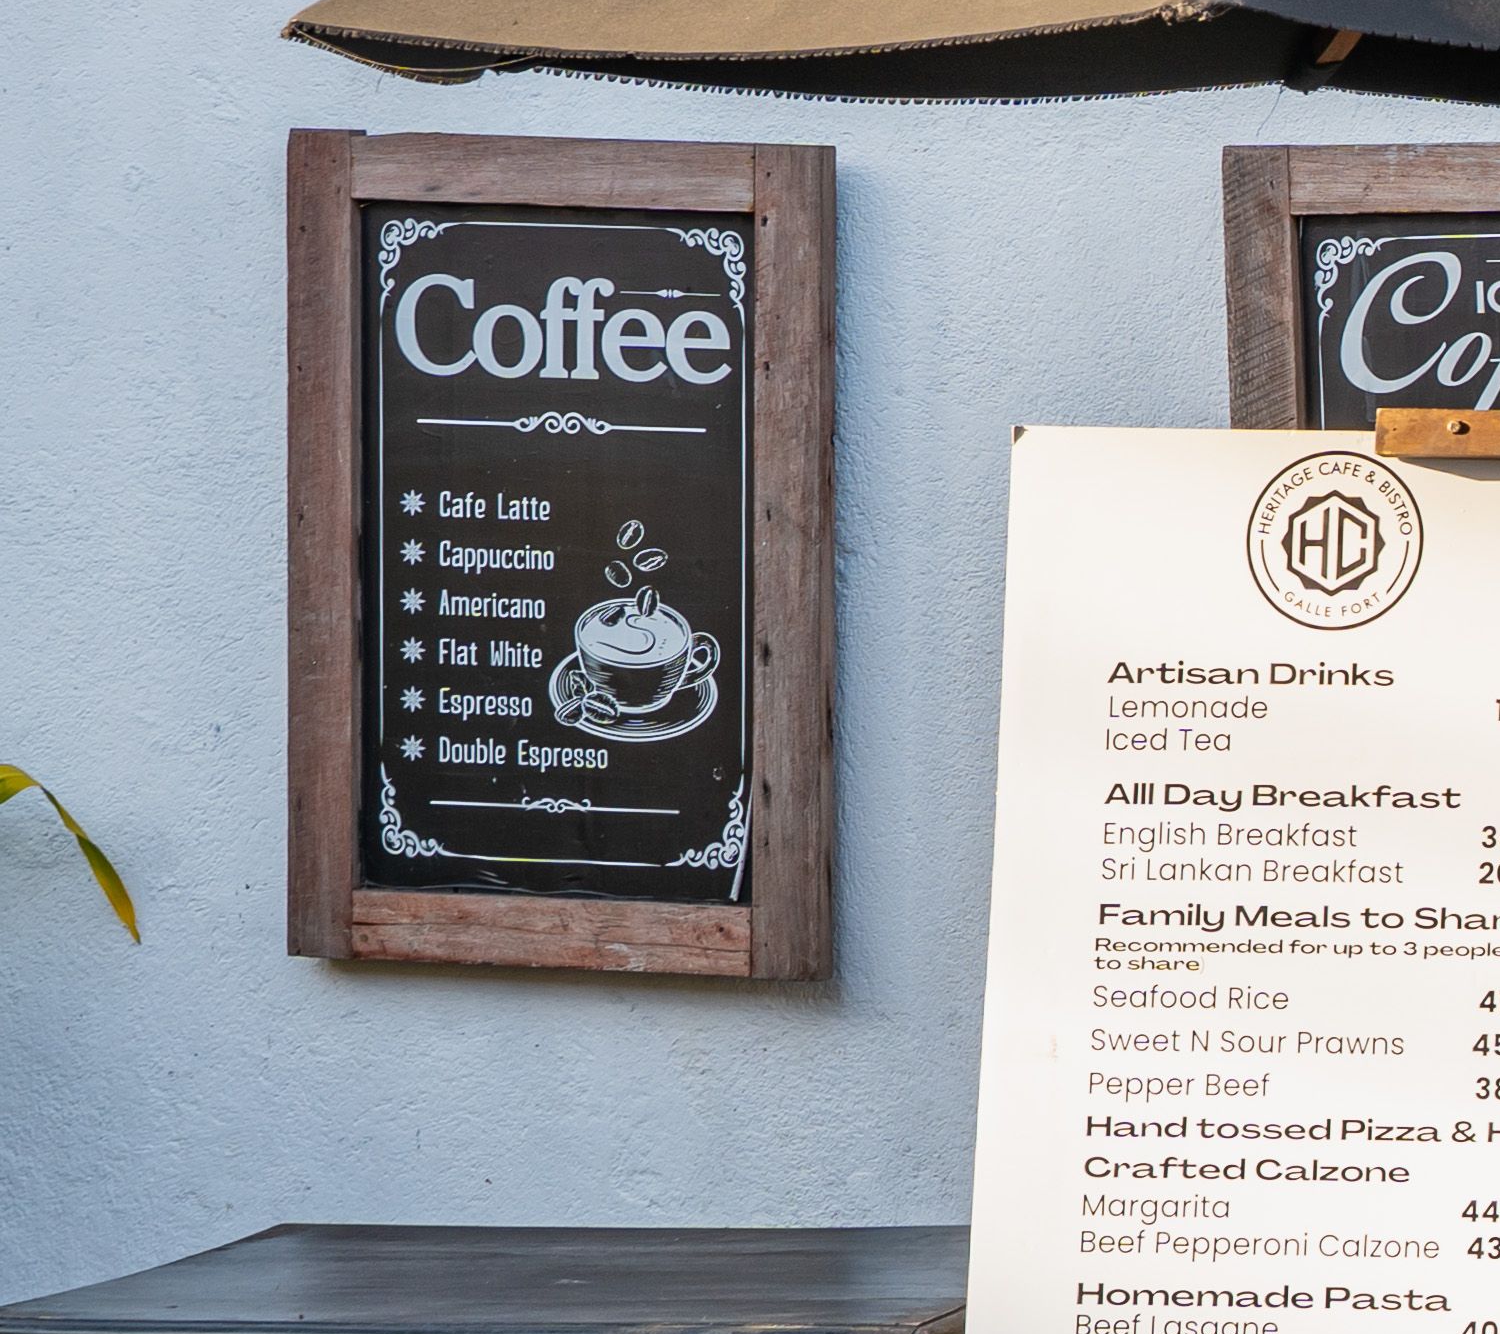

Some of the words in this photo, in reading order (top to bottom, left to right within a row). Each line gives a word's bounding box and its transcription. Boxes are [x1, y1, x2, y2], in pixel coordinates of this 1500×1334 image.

[395, 273, 733, 385] Coffee
[439, 490, 486, 519] Cafe
[497, 492, 551, 521] Latte
[1258, 467, 1313, 535] HERITAGE
[1319, 462, 1362, 477] CAFE
[1365, 470, 1376, 485] &
[1378, 481, 1413, 536] BISTRO
[439, 539, 555, 575] Cappuccino
[438, 588, 546, 620] Americano
[1284, 591, 1332, 618] GALLE
[1341, 592, 1381, 617] FORT
[438, 637, 478, 666] Flat
[490, 640, 543, 669] White
[1107, 660, 1259, 685] Artisan
[1269, 661, 1394, 687] Drinks
[439, 687, 533, 721] Espresso
[438, 735, 507, 765] Double
[517, 739, 608, 773] Espresso
[1163, 783, 1243, 813] Day
[1252, 784, 1461, 809] Breakfast
[1103, 821, 1206, 853] English
[1217, 822, 1357, 848] Breakfast
[1101, 856, 1136, 880] Sri
[1146, 857, 1252, 882] Lankan
[1263, 859, 1404, 884] Breakfast
[1099, 902, 1225, 933] Family
[1235, 905, 1351, 929] Meals
[1360, 907, 1404, 929] to
[1093, 956, 1122, 970] to
[1095, 937, 1284, 954] Recommended
[1288, 939, 1328, 955] for
[1333, 944, 1364, 959] up
[1369, 941, 1397, 956] to
[1403, 941, 1418, 956] 3
[1091, 1028, 1181, 1052] Sweet
[1191, 1029, 1209, 1052] N
[1220, 1030, 1287, 1054] Sour
[1297, 1031, 1404, 1056] Prawns
[1086, 1115, 1188, 1138] Hand
[1196, 1118, 1332, 1141] tossed
[1341, 1118, 1442, 1143] Pizza
[1451, 1120, 1476, 1143] &
[1084, 1156, 1246, 1180] Crafted
[1255, 1158, 1410, 1183] Calzone
[1080, 1229, 1145, 1254] Beef
[1155, 1231, 1308, 1263] Pepperoni
[1318, 1234, 1440, 1259] Calzone
[1076, 1282, 1314, 1309] Homemade
[1324, 1286, 1452, 1312] Pasta
